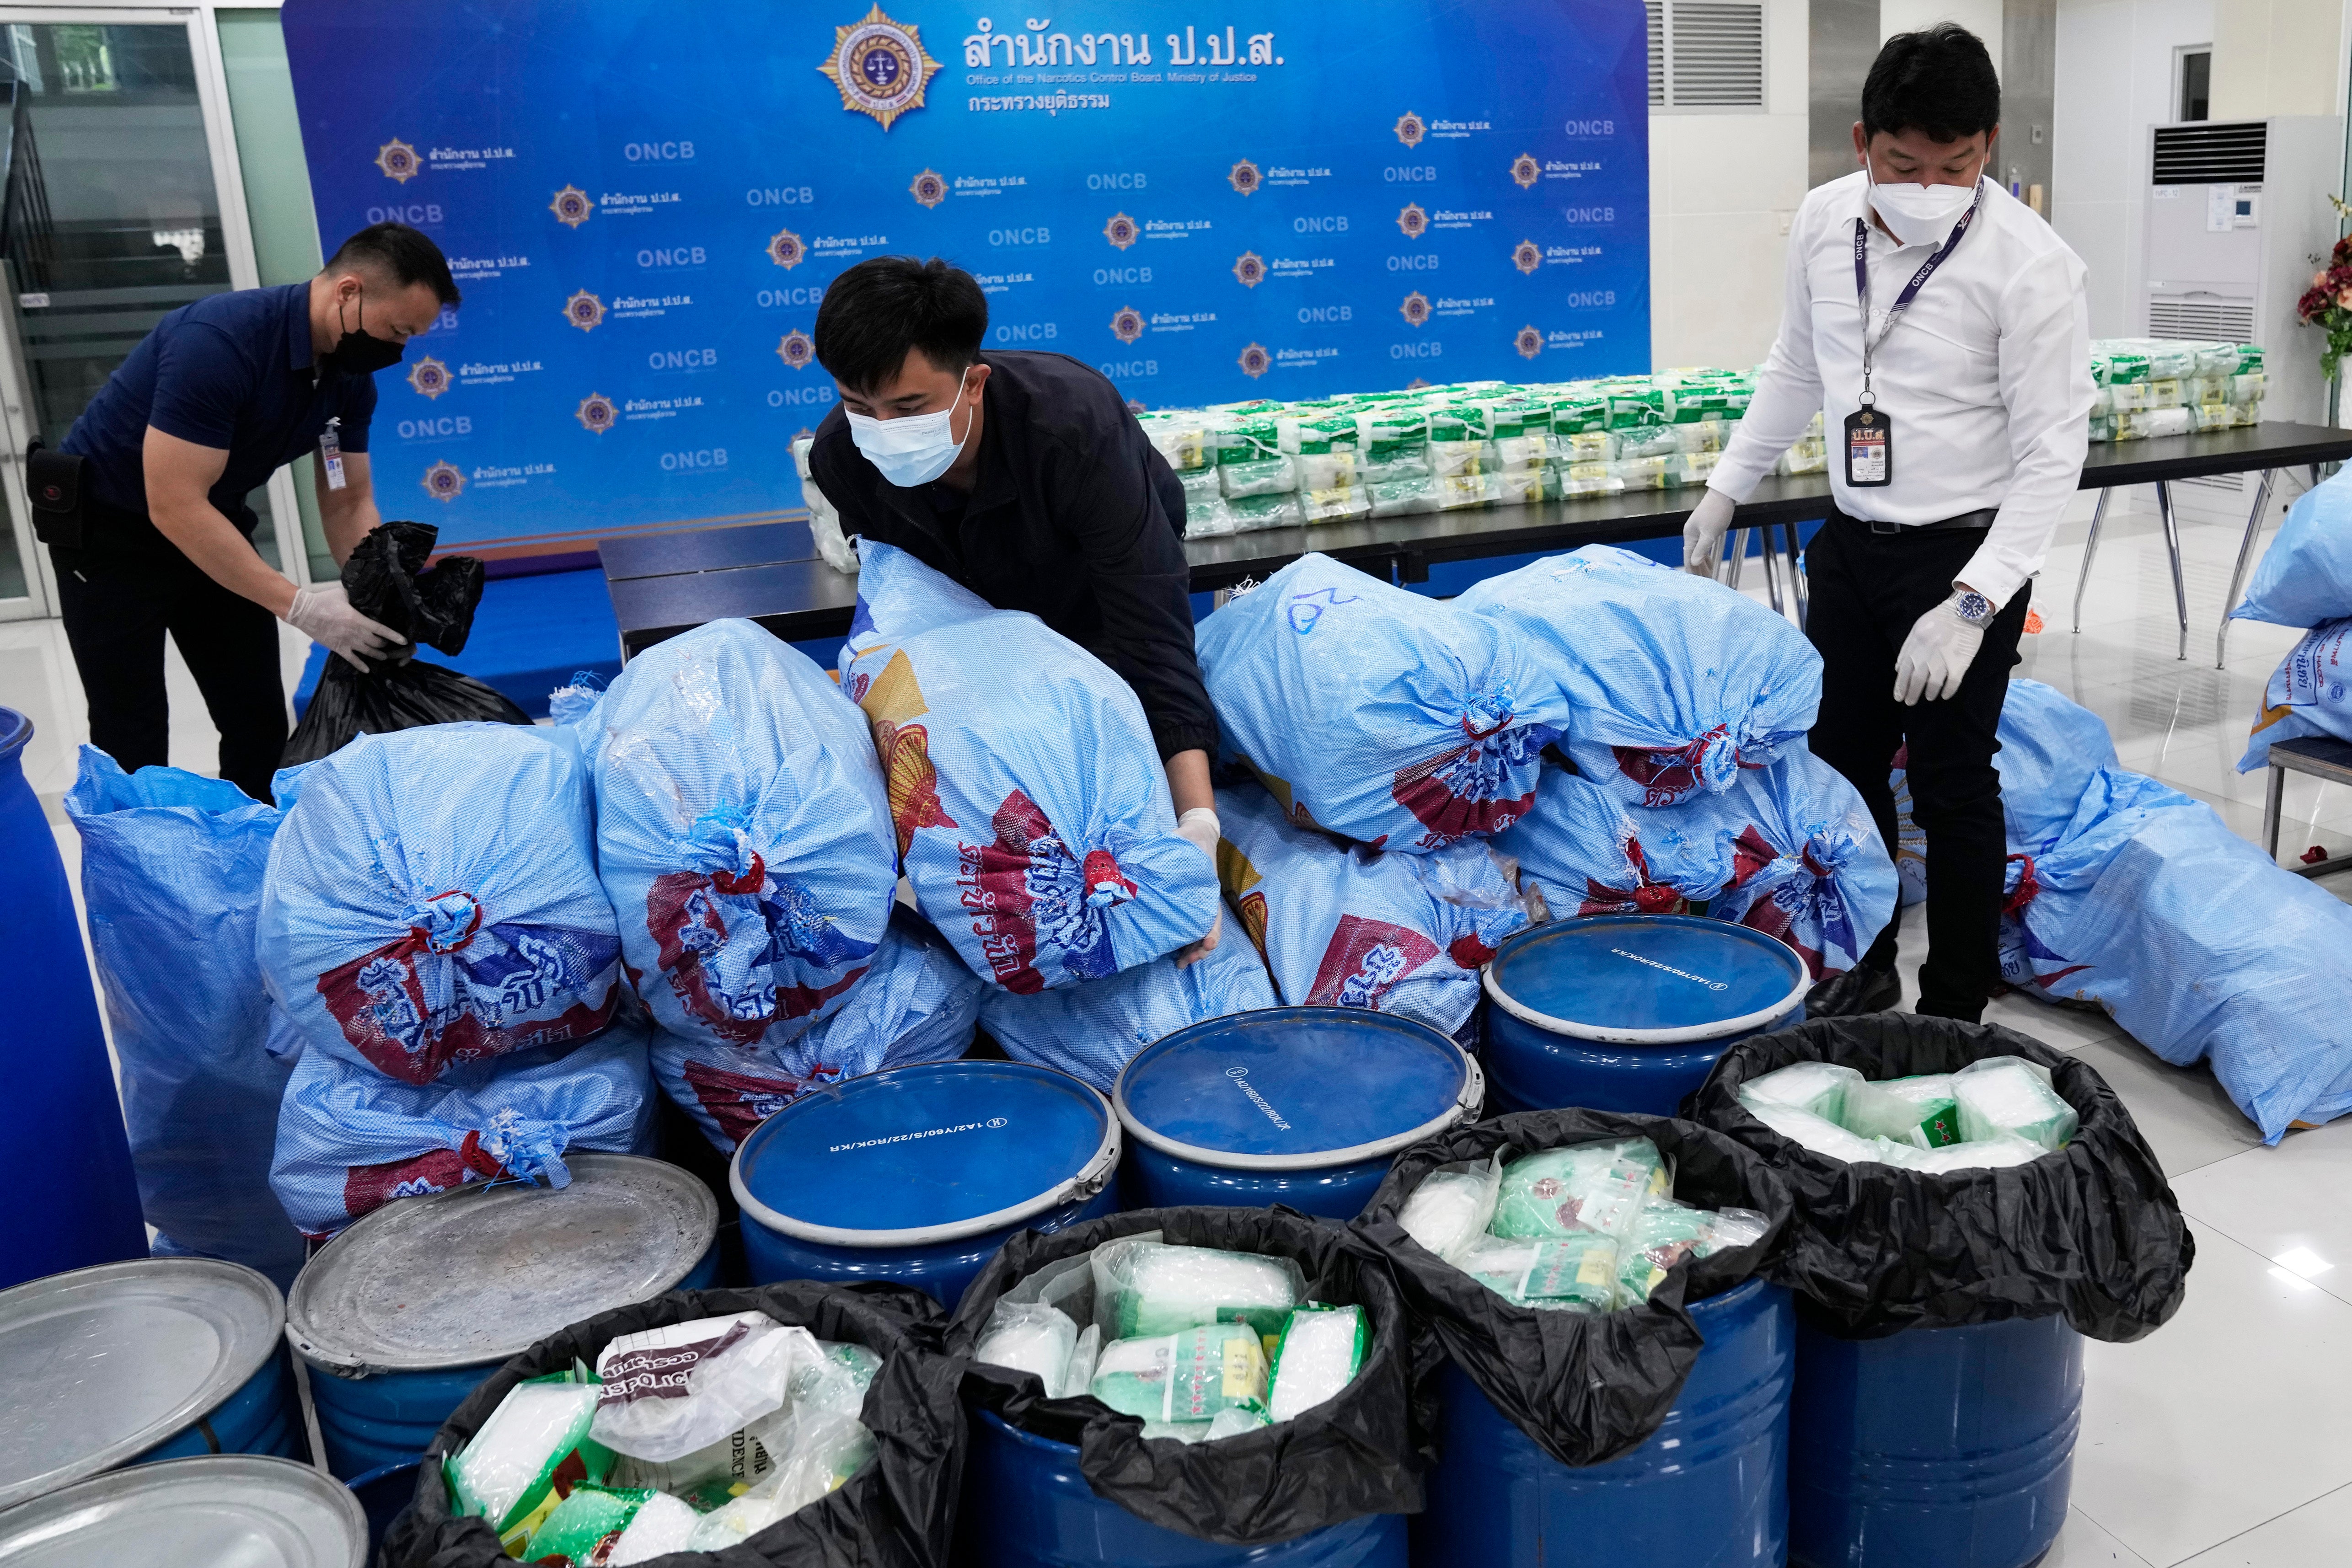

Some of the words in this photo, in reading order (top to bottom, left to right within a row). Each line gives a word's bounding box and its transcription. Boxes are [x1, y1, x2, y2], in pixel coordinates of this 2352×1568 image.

[963, 17, 1152, 67] สำนักงาน
[1167, 26, 1284, 65] ป.ป.ส.
[966, 75, 999, 85] Office
[1002, 74, 1013, 84] of
[1017, 75, 1034, 83] the
[1038, 74, 1087, 83] Narcotics
[1090, 73, 1127, 82] Control
[1167, 73, 1205, 84] Ministry
[1209, 73, 1219, 81] of
[1222, 73, 1257, 82] Justice
[969, 89, 1109, 116] กระทรวงยุติธรรม
[1566, 120, 1614, 135] ONCB
[625, 141, 695, 161] ONCB
[1087, 173, 1147, 189] ONCB
[1384, 166, 1436, 182] ONCB
[747, 187, 814, 206] ONCB
[367, 205, 443, 224] ONCB
[1294, 216, 1349, 232] ONCB
[1566, 208, 1614, 223] ONCB
[989, 227, 1050, 246] ONCB
[638, 247, 706, 267] ONCB
[1386, 255, 1439, 270] ONCB
[1093, 268, 1152, 285] ONCB
[1912, 263, 1934, 287] ONCB
[757, 287, 823, 307] ONCB
[1568, 291, 1616, 308] ONCB
[1298, 306, 1352, 323] ONCB
[996, 323, 1057, 342] ONCB
[649, 349, 718, 370] ONCB
[1390, 342, 1442, 359] ONCB
[1100, 360, 1158, 379] ONCB
[767, 386, 833, 407] ONCB
[397, 416, 472, 438] ONCB
[661, 448, 728, 471] ONCB
[1611, 948, 1711, 985] 1A2/Y60/S/22/ROK/KR
[1233, 1078, 1291, 1131] 1A2/Y60/S/22/ROK/KR
[830, 1122, 983, 1152] 1A2/Y60/S/22/ROK/KR
